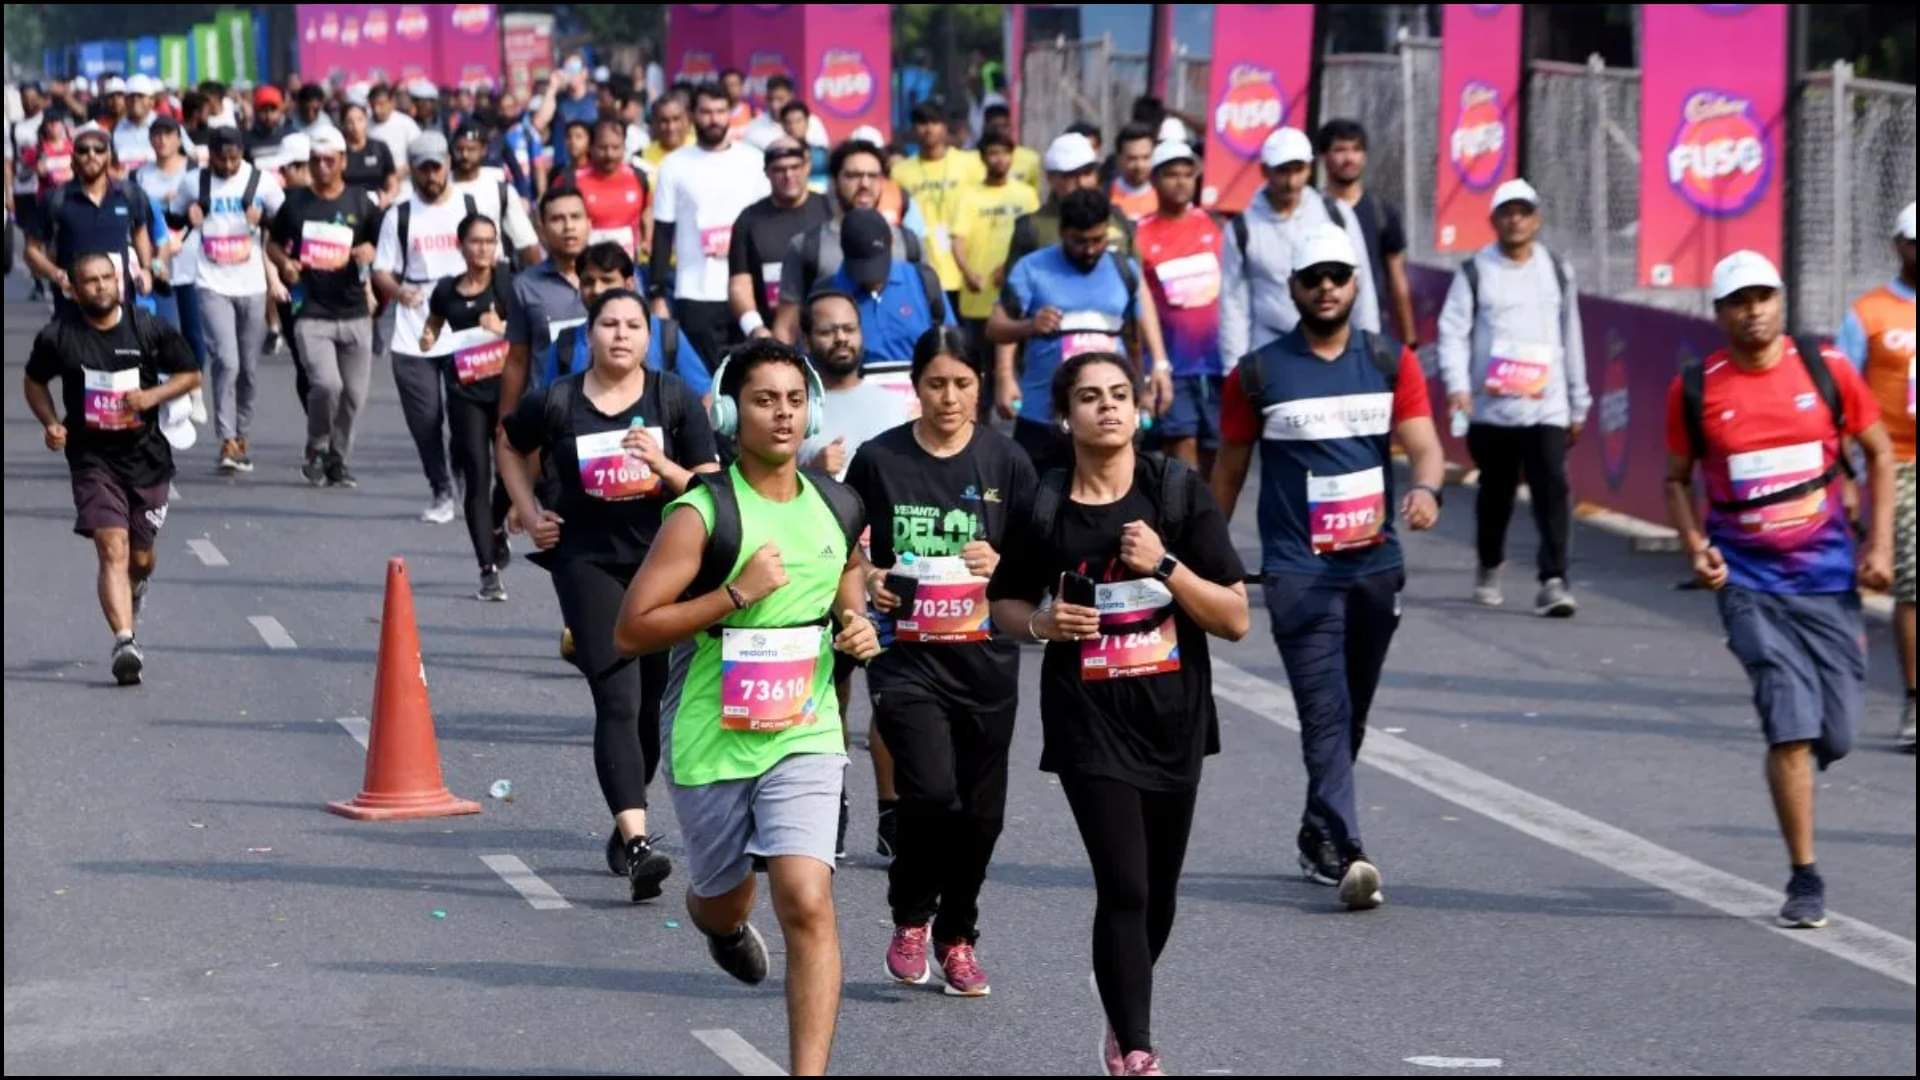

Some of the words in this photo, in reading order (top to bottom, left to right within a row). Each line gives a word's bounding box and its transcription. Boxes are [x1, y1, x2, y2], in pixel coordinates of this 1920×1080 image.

[894, 504, 940, 518] VEDANTA
[913, 598, 974, 617] 70259
[740, 677, 805, 701] 73610
